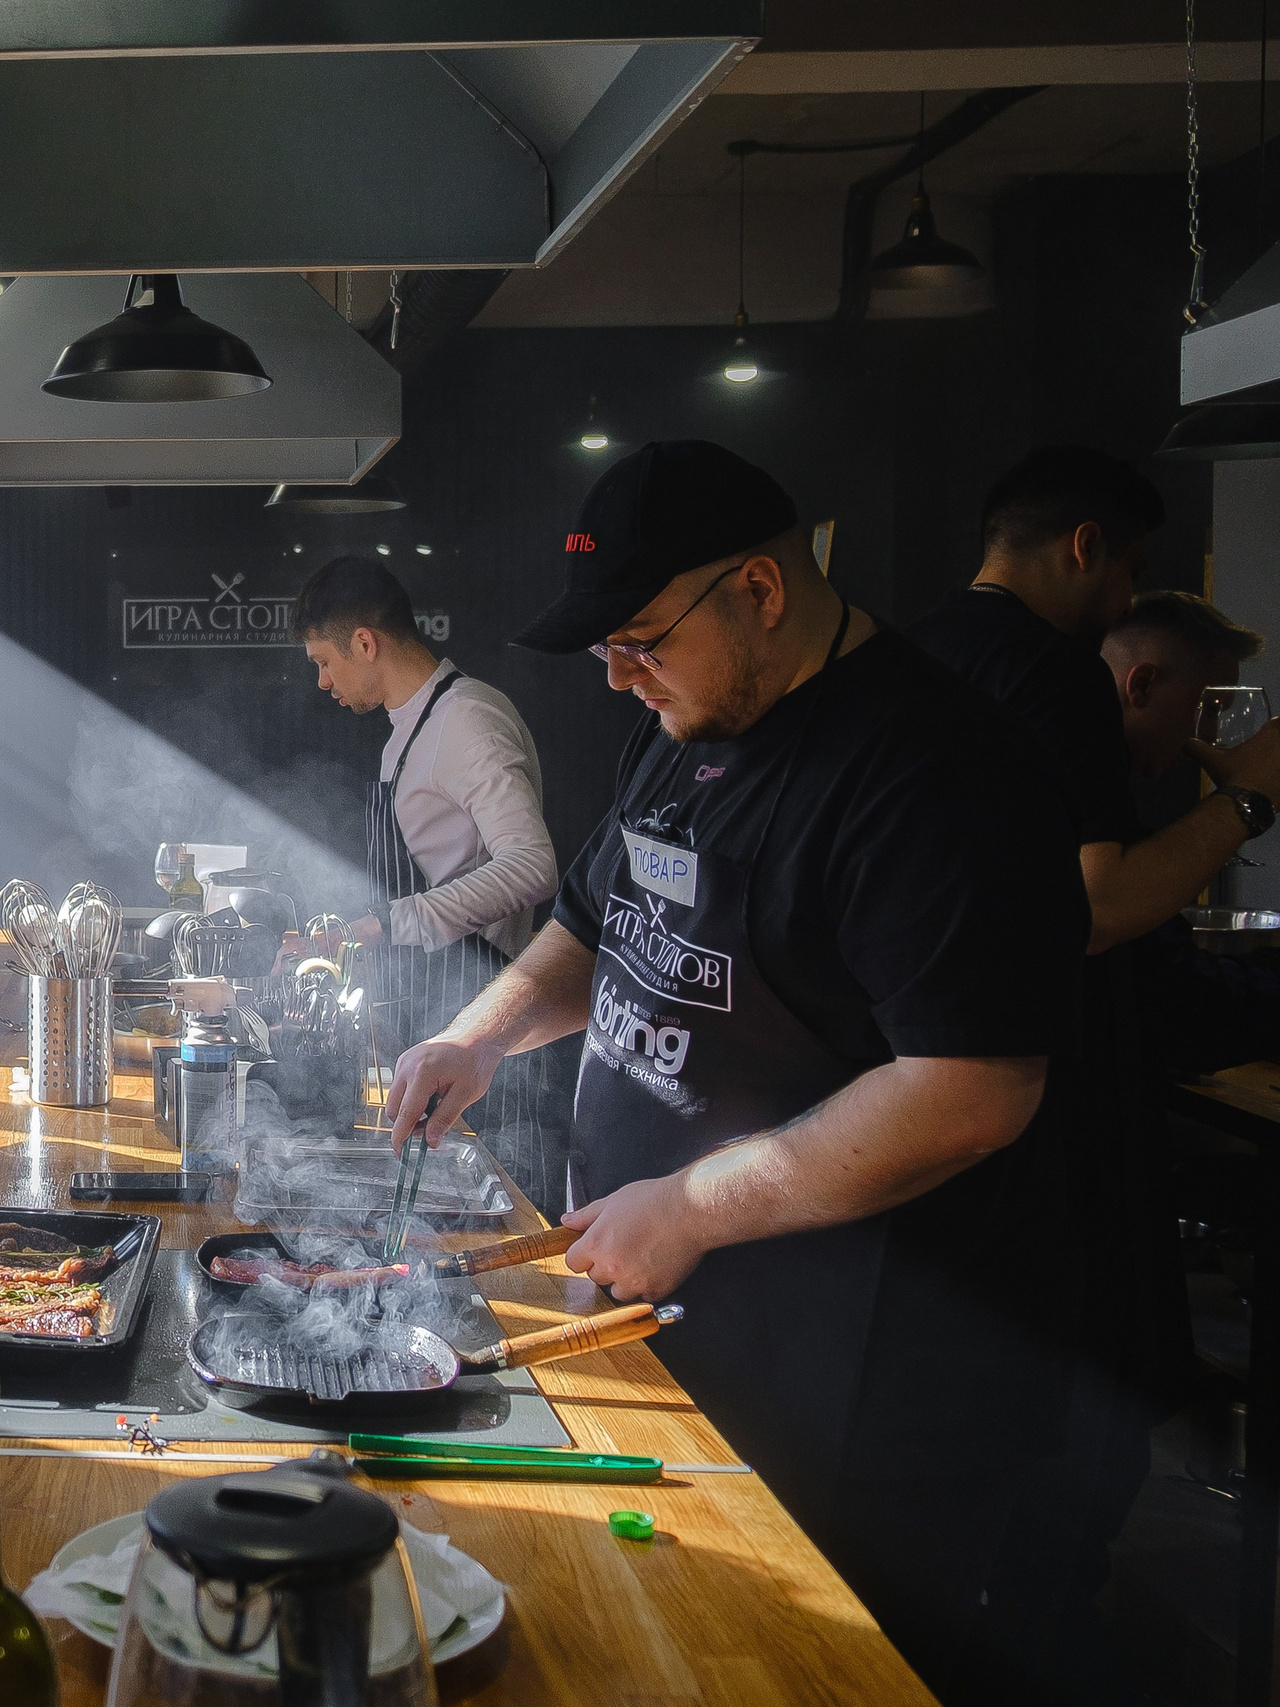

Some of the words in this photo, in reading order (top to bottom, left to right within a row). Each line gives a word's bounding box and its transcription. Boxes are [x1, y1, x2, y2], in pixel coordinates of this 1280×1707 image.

[131, 605, 203, 630] ИГРА
[209, 604, 293, 630] СТОЛ
[158, 632, 240, 642] КУЛИНАРНАЯ
[246, 632, 291, 642] СТУДИ
[634, 847, 688, 883] ПОВАР
[647, 932, 721, 988] СТОЛОВ
[654, 1014, 681, 1026] 1889
[623, 1063, 679, 1091] техника
